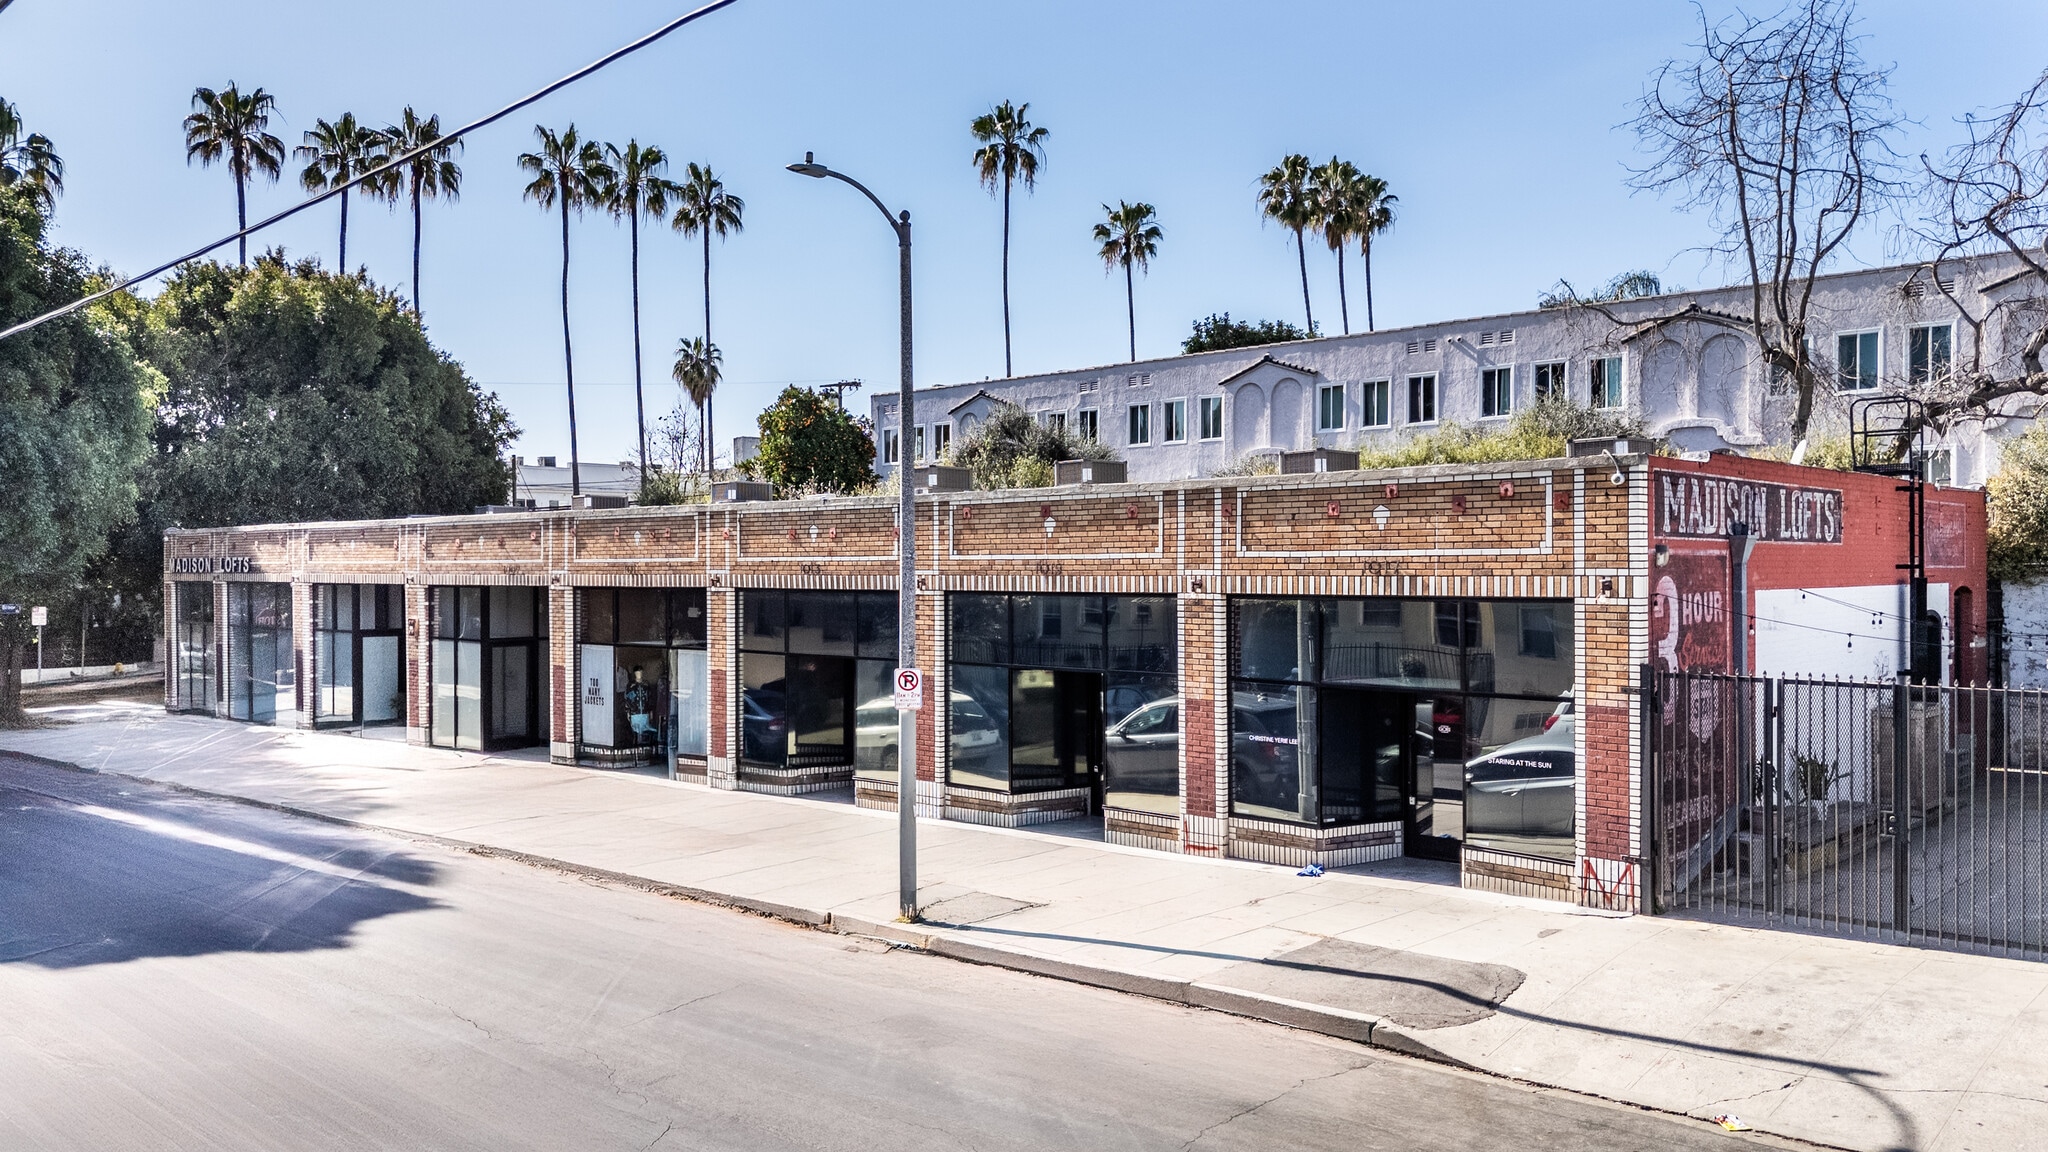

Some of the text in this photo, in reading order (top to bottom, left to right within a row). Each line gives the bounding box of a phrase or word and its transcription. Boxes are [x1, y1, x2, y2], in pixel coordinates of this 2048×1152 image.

[1662, 475, 1767, 538] MADISON
[1779, 488, 1835, 541] LOFTS
[169, 556, 249, 573] MADISON LOFTS
[1682, 591, 1723, 626] HOUR
[1487, 757, 1515, 766] STARING
[1524, 760, 1537, 768] THE
[1538, 761, 1552, 769] SUN
